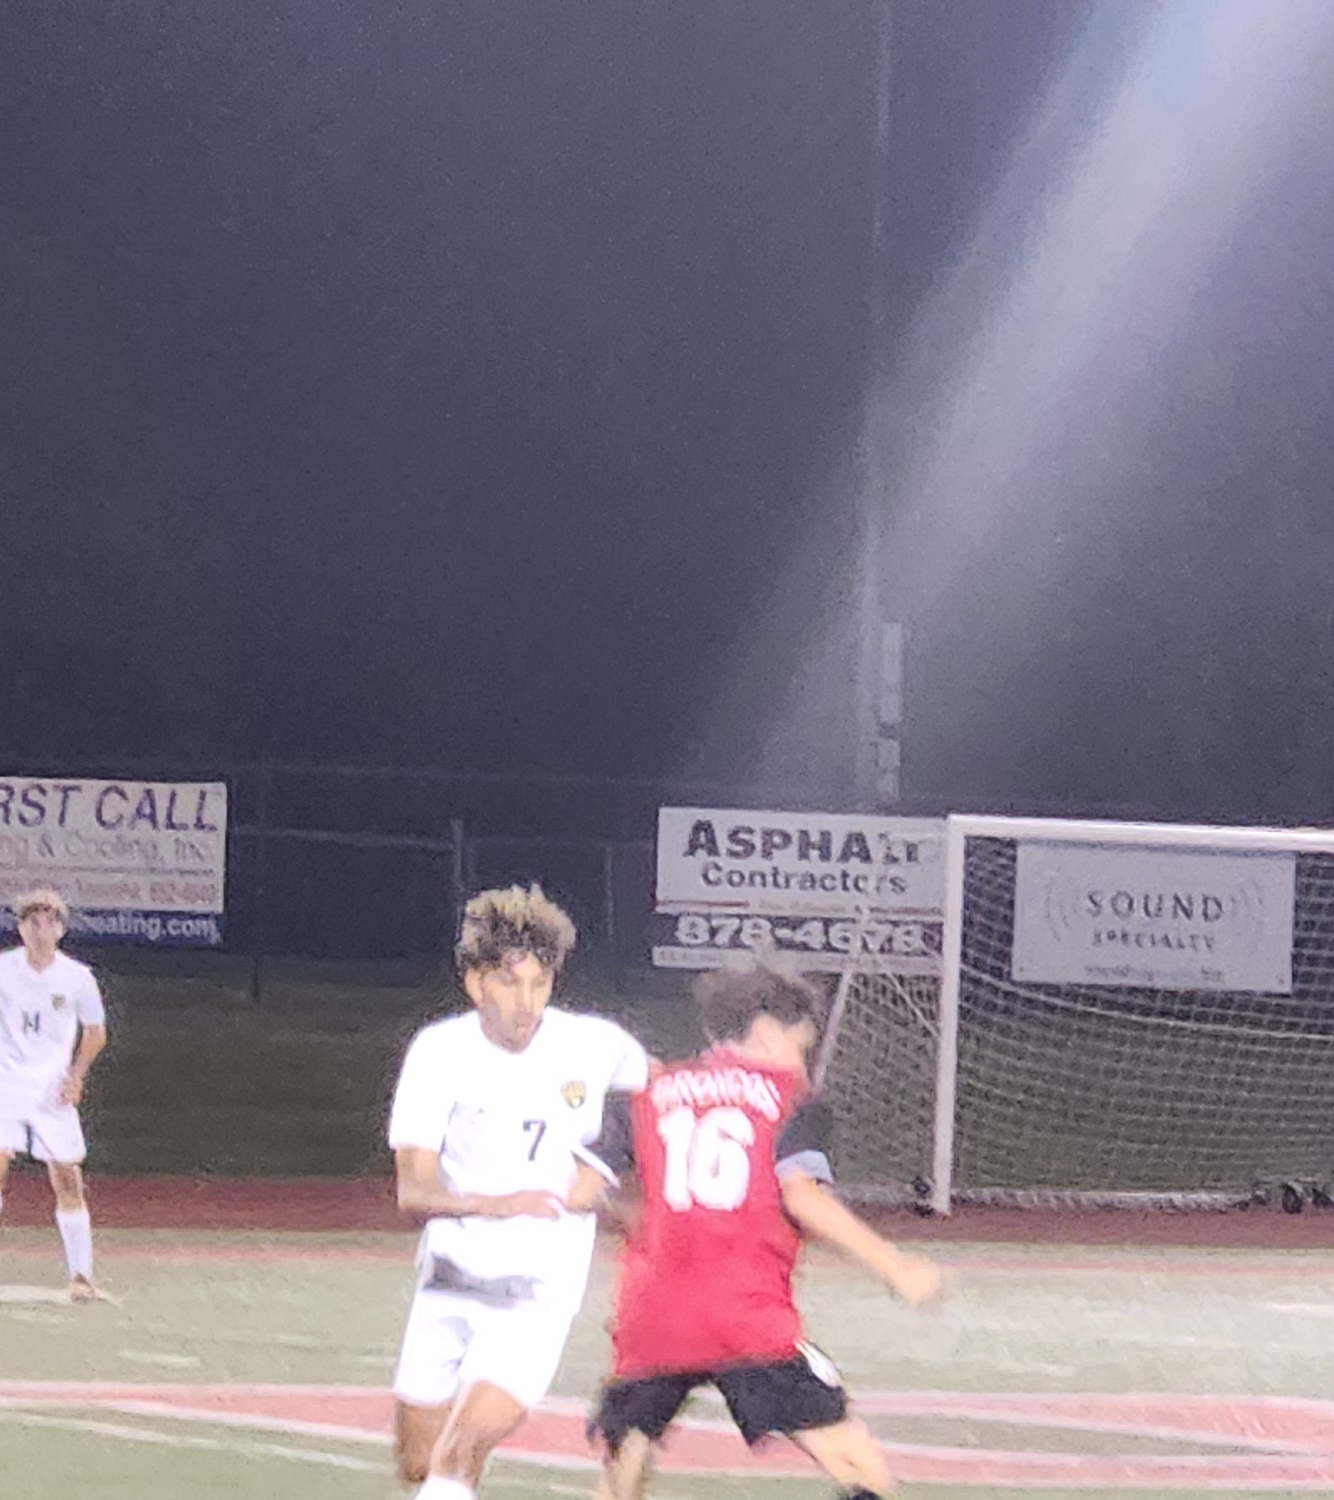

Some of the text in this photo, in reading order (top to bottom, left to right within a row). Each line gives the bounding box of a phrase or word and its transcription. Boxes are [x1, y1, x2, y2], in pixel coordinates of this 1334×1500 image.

[94, 784, 219, 831] CALL
[700, 861, 910, 895] Contractors
[1085, 889, 1225, 923] SOUND
[522, 1118, 547, 1162] 7
[656, 1105, 755, 1212] 16
